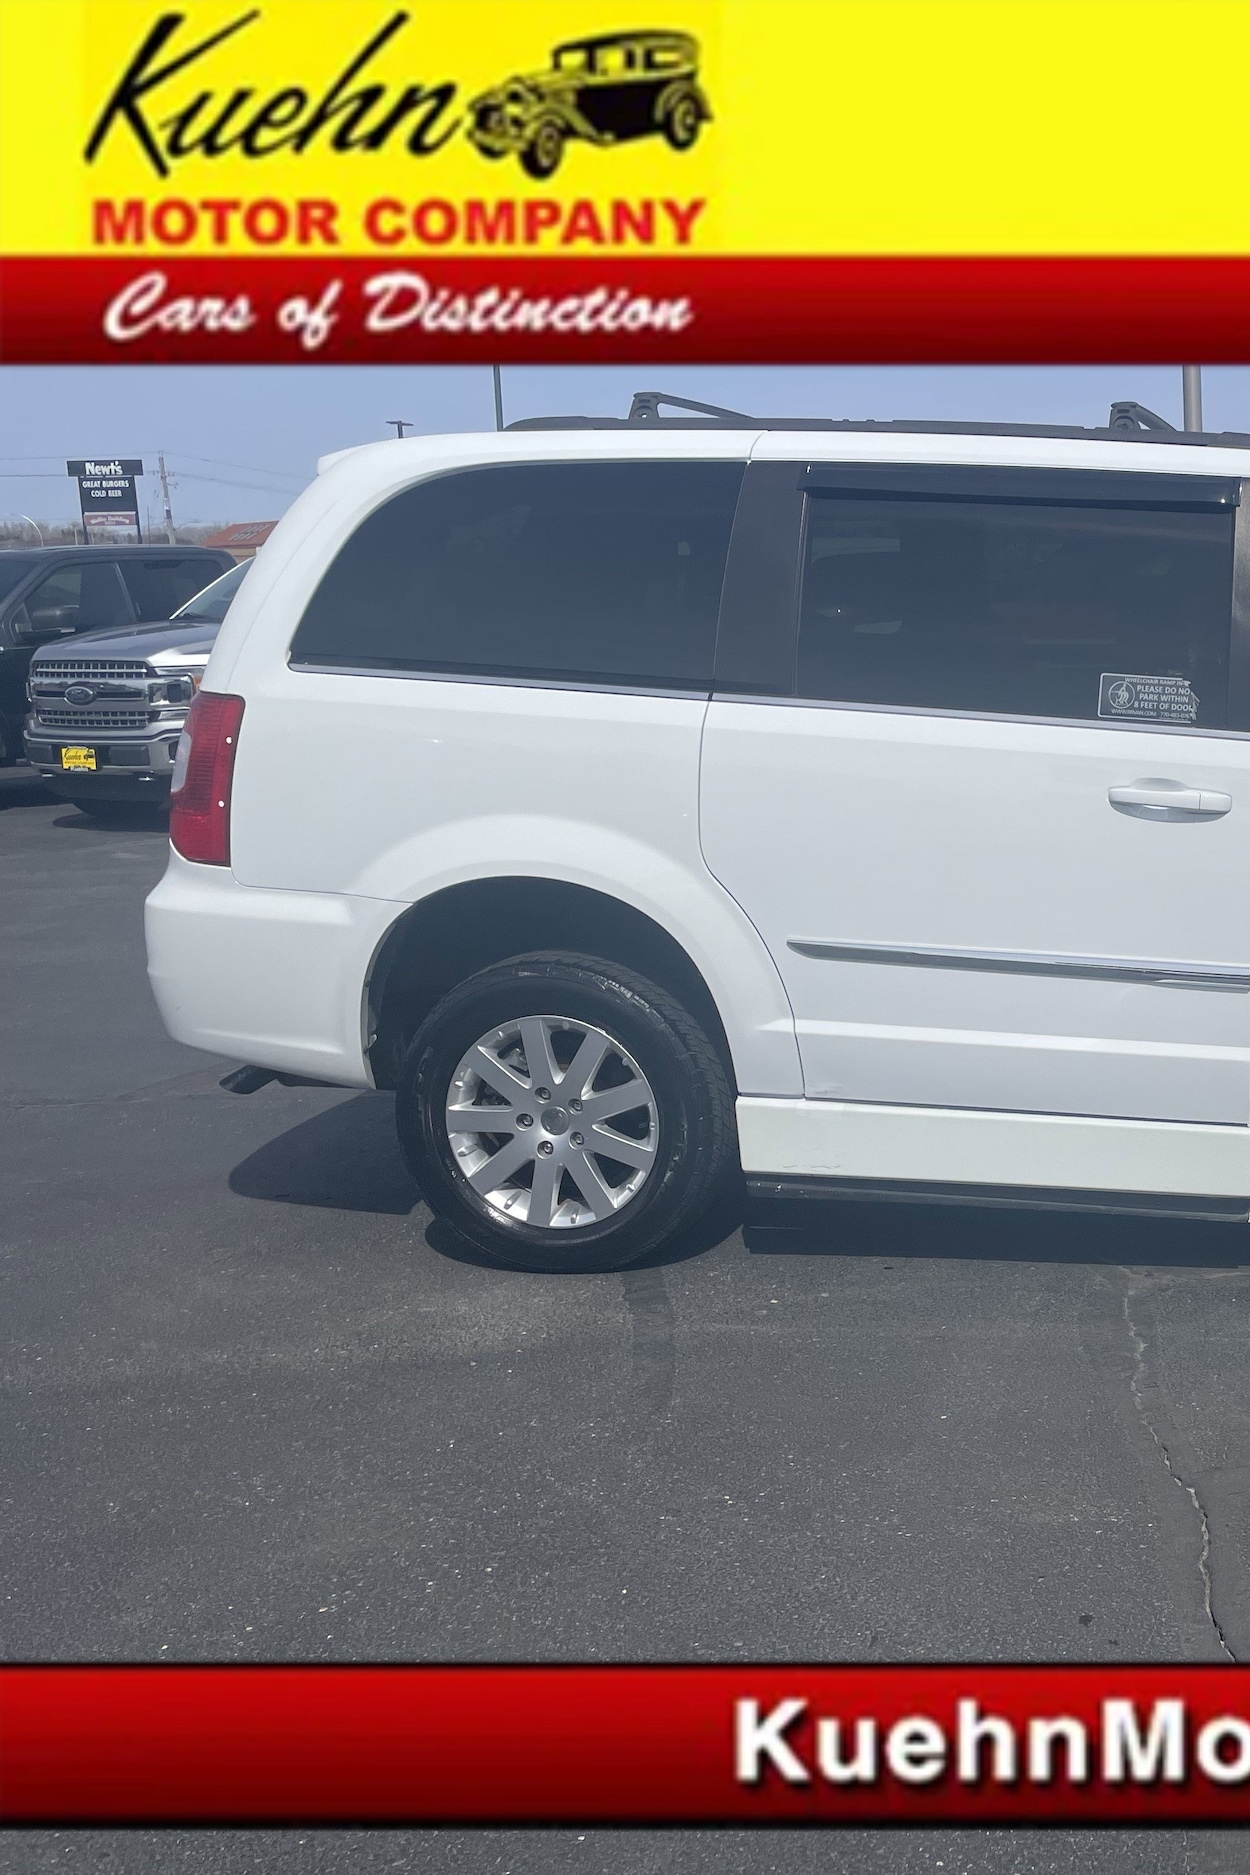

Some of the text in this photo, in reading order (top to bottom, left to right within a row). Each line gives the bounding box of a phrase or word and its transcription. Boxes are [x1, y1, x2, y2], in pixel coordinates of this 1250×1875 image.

[85, 460, 123, 475] Newt's
[82, 480, 129, 488] GREAT BURGERS
[1125, 677, 1158, 685] WHEELCHAIR
[1137, 685, 1163, 693] PLEASE
[1139, 693, 1188, 703] PARK WITHIN
[1141, 701, 1157, 709] FEET
